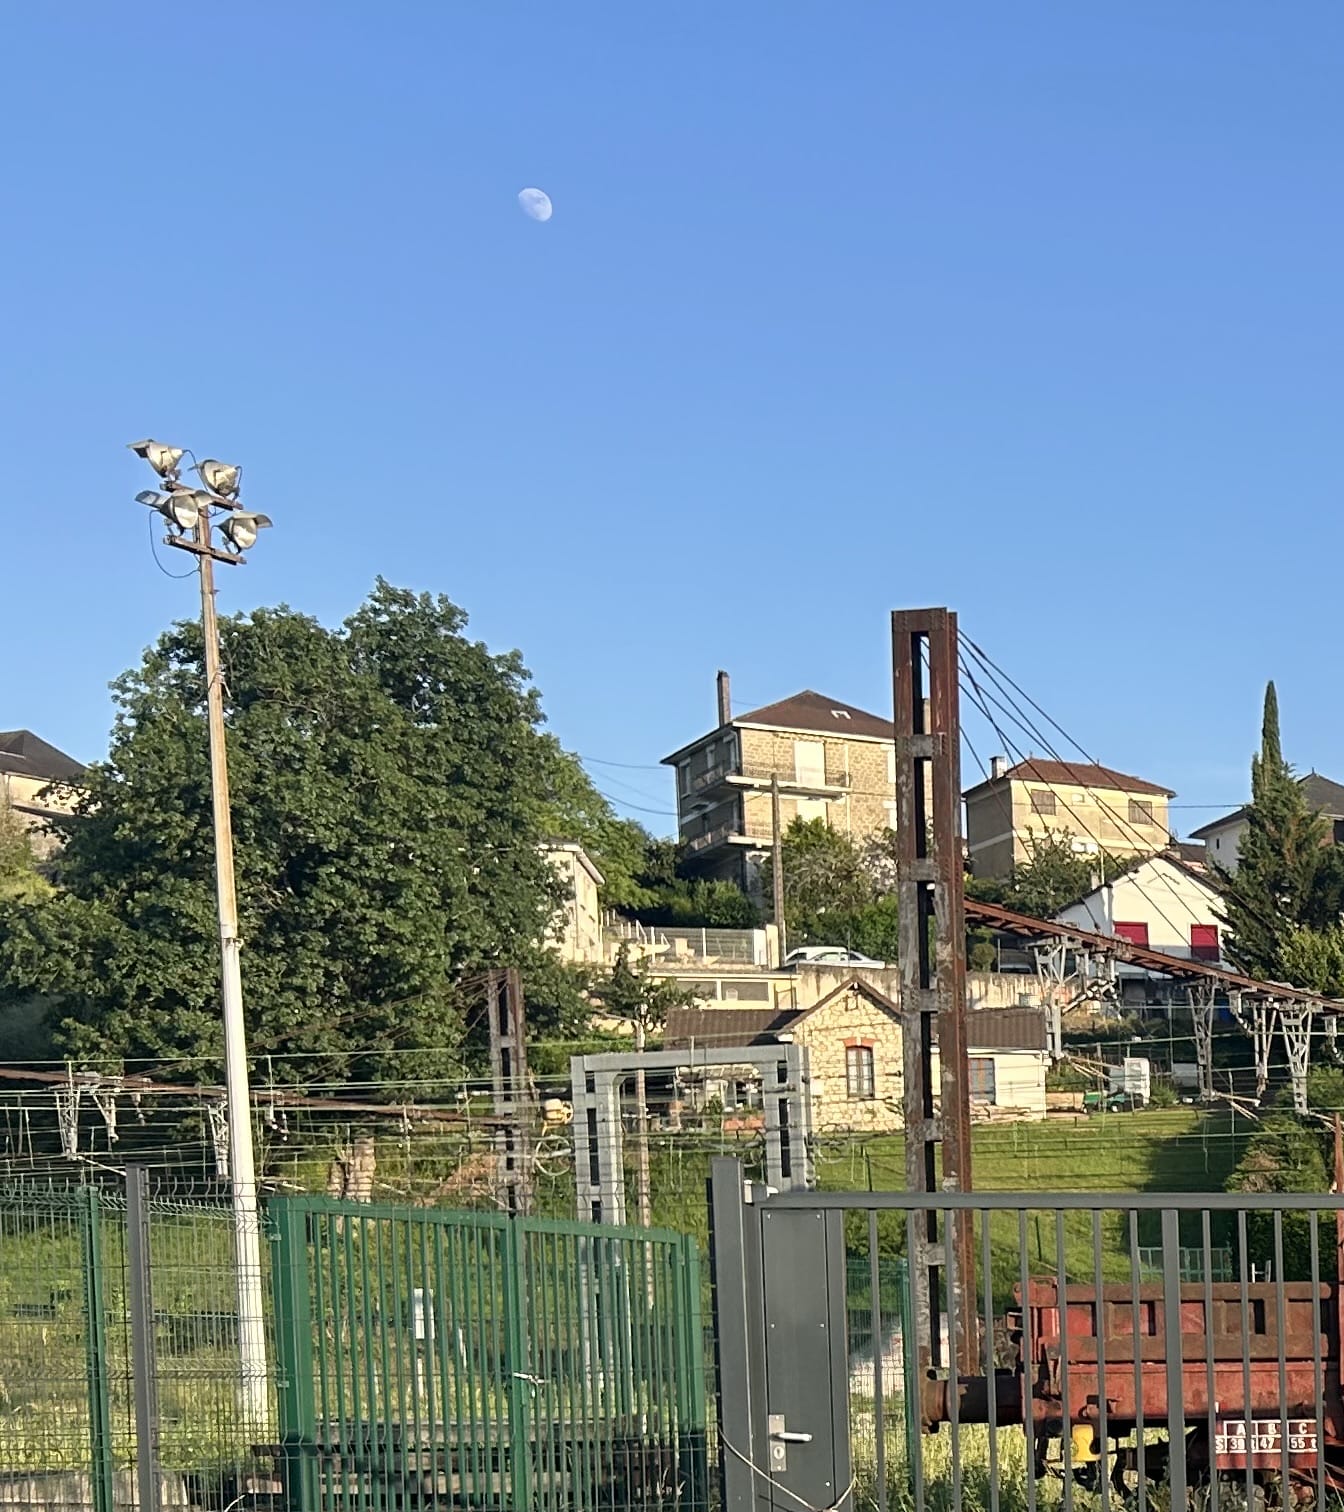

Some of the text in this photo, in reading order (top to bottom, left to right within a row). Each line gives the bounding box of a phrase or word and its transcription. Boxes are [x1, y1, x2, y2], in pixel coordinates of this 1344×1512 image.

[1236, 1423, 1246, 1436] A
[1267, 1423, 1277, 1434] B
[1299, 1423, 1308, 1434] C
[1215, 1438, 1224, 1450] S
[1260, 1437, 1275, 1449] 47
[1291, 1437, 1306, 1449] 55
